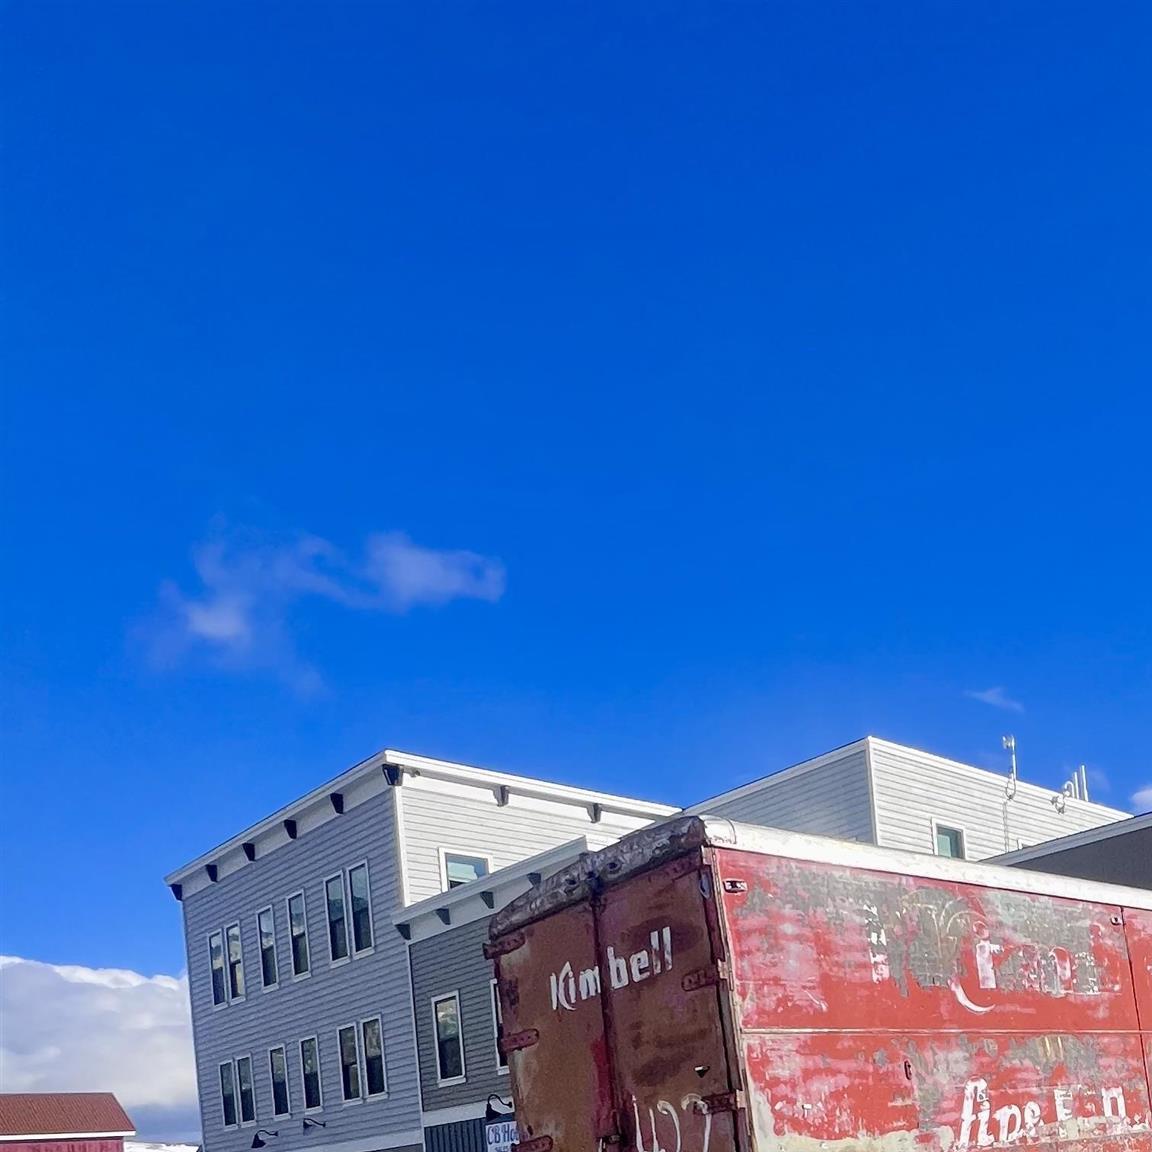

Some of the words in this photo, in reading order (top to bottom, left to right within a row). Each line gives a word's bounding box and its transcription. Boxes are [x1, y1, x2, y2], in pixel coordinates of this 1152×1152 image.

[549, 926, 674, 1011] Kimbell
[488, 1125, 501, 1145] CB
[501, 1123, 519, 1142] Ho
